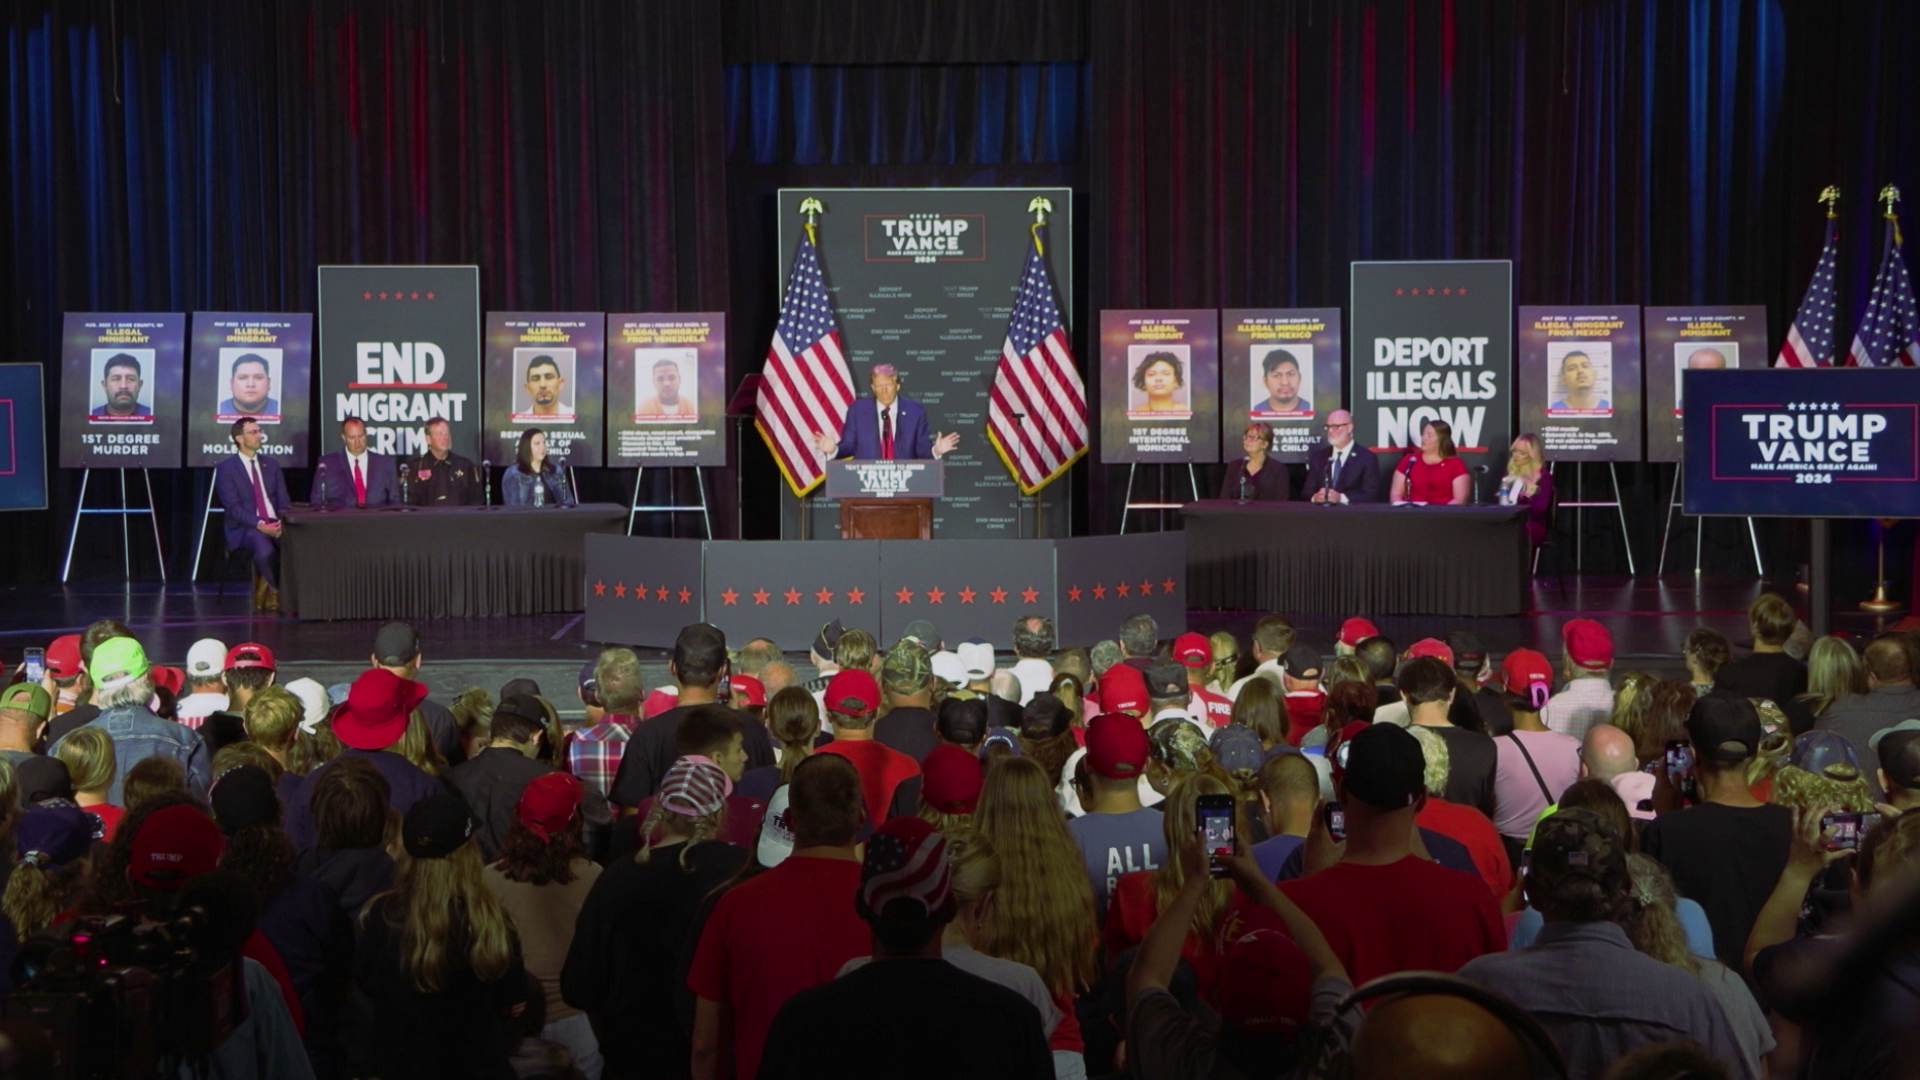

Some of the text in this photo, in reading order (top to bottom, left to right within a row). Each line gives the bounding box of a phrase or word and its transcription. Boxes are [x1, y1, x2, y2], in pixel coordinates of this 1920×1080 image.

[882, 220, 968, 236] TRUMP
[892, 236, 958, 250] VANCE
[1374, 337, 1488, 366] DEPORT
[356, 342, 445, 384] END
[1366, 370, 1496, 400] ILLEGALS
[336, 393, 466, 422] MIGRANT
[1378, 406, 1486, 448] NOW
[1742, 414, 1887, 440] TRUMP
[82, 434, 160, 444] 1ST DEGREE
[366, 427, 428, 456] CRIM
[93, 445, 148, 454] MURDER
[1758, 442, 1870, 462] VANCE
[857, 470, 912, 480] TRUMP
[864, 480, 907, 489] VANCE
[1794, 473, 1832, 484] 2024
[1208, 702, 1232, 714] FIRE
[1107, 843, 1159, 875] ALL
